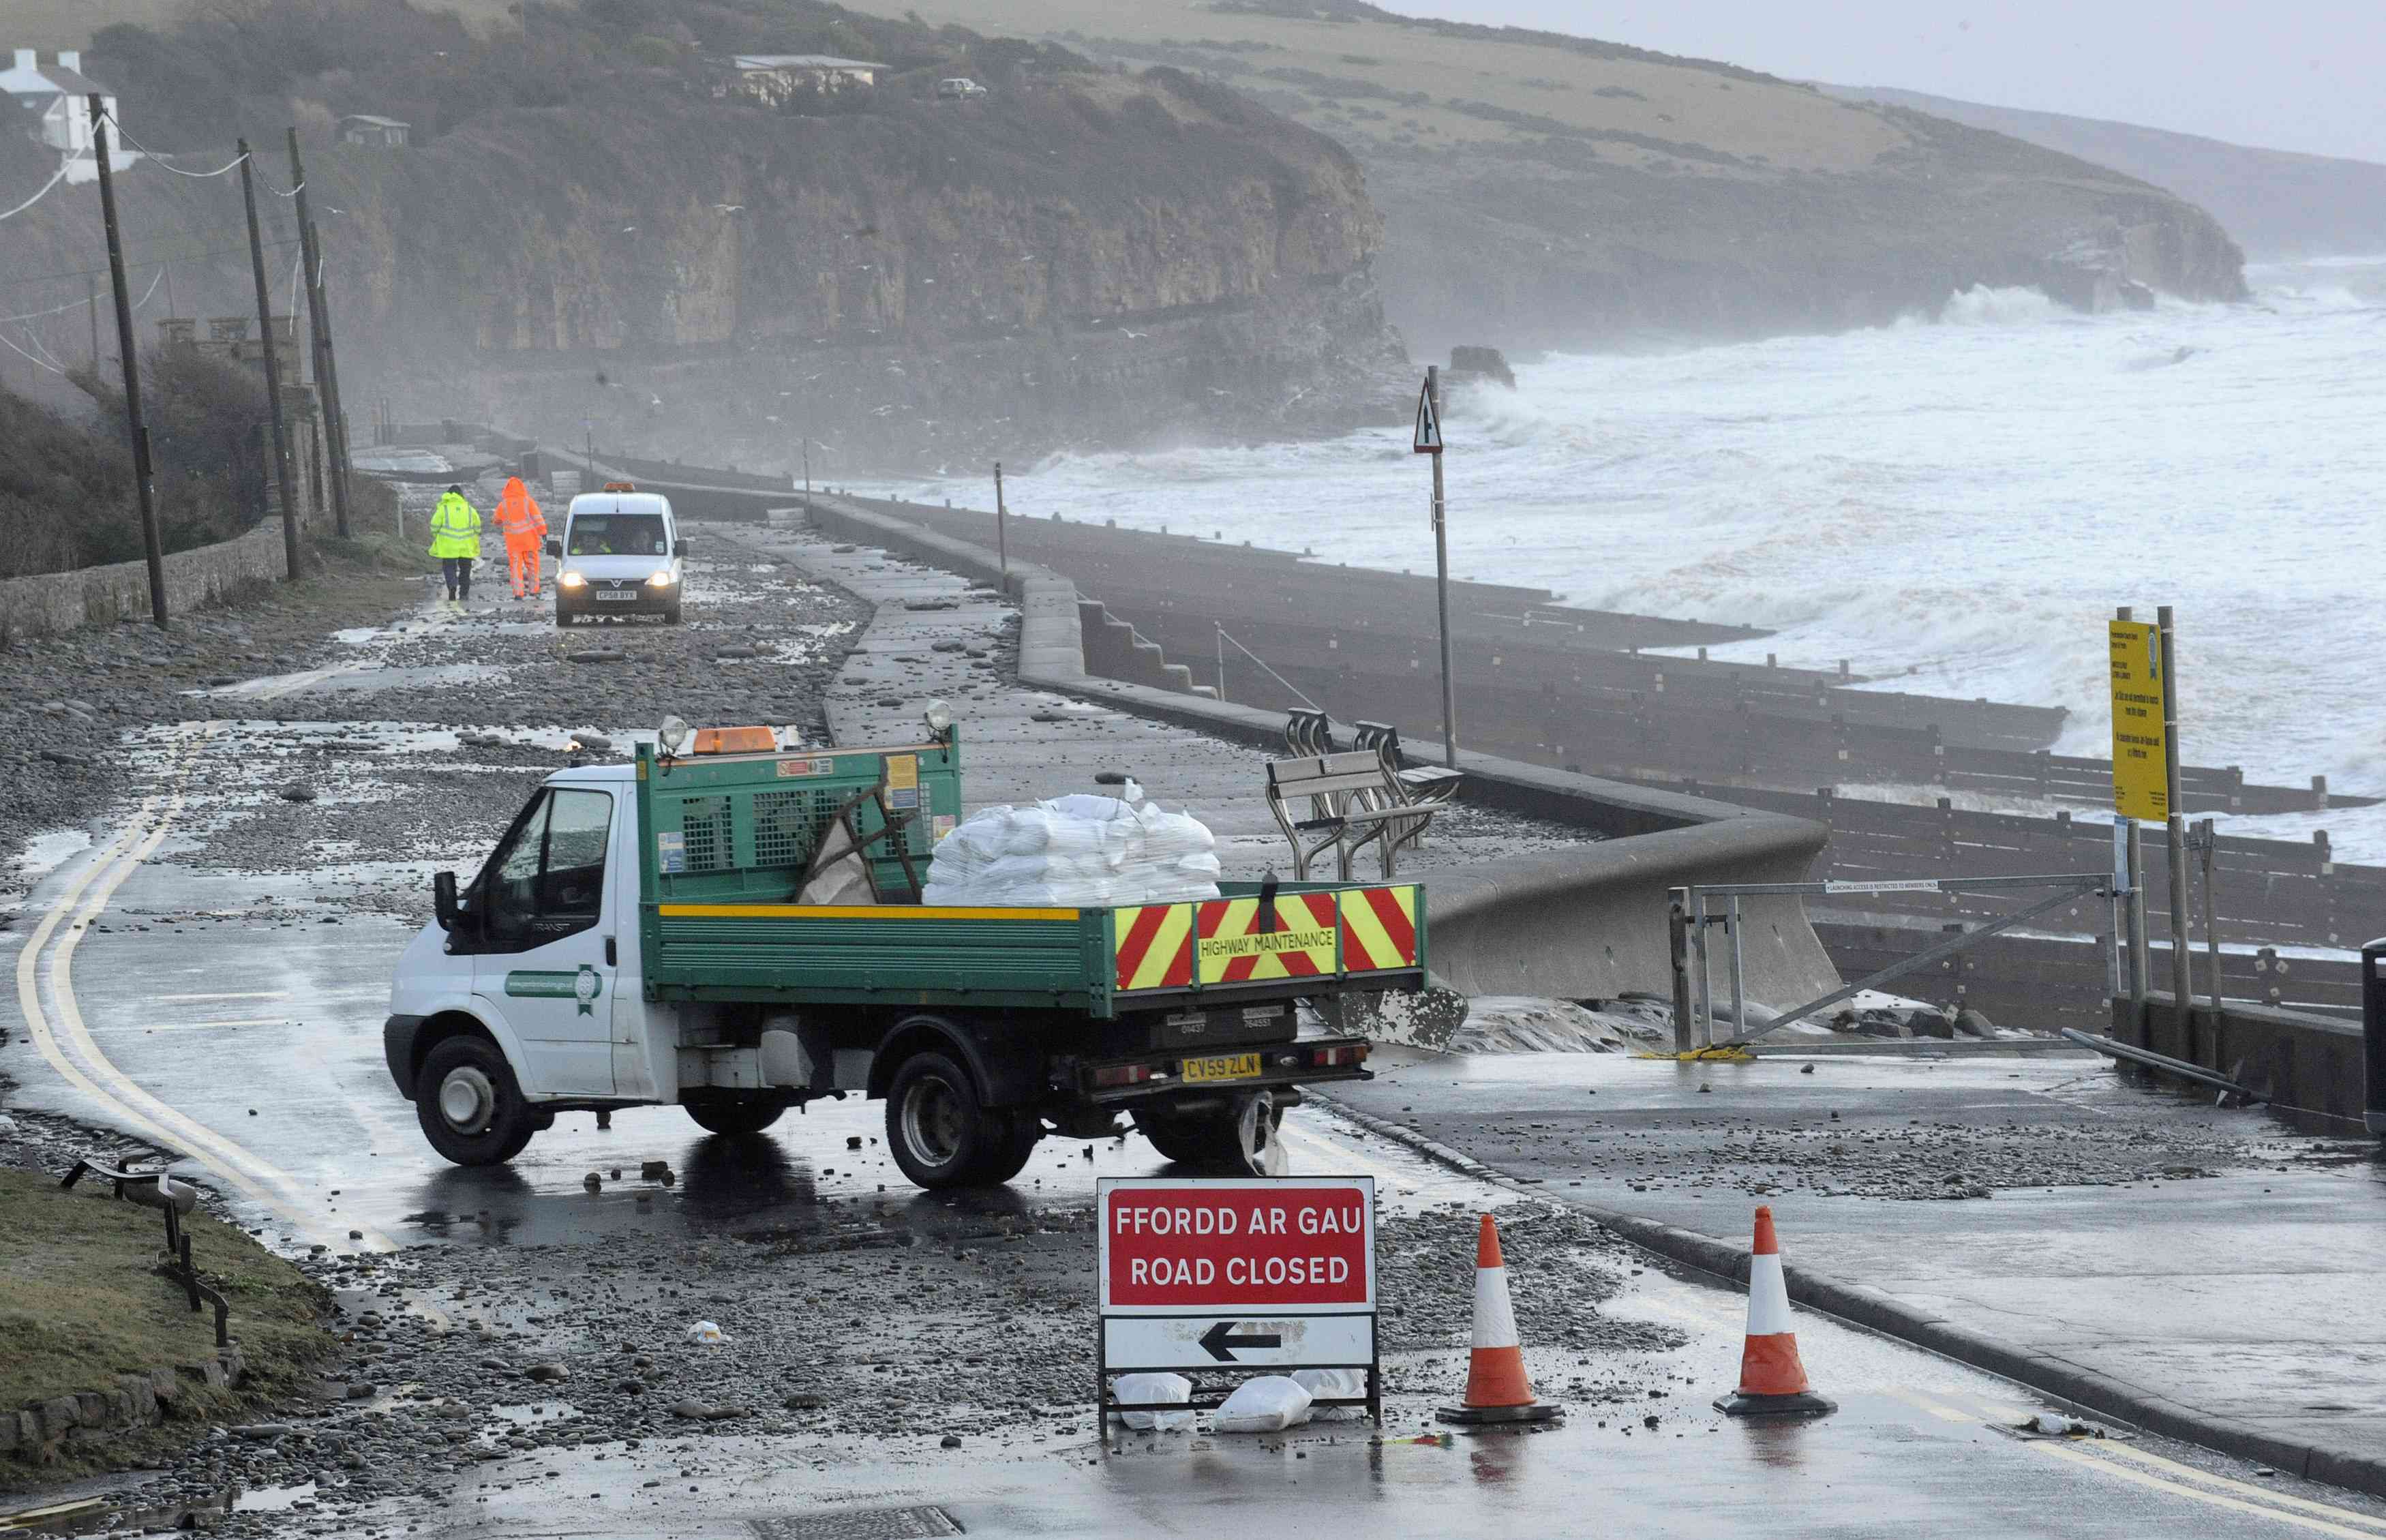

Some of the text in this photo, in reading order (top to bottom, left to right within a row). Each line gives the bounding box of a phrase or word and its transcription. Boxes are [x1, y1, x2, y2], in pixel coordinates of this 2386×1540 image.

[1200, 930, 1333, 956] HIGHWAY MAINTENANCE
[1188, 1055, 1256, 1078] CV59 ZLN
[1115, 1207, 1361, 1235] FFORDD AR GAU
[1131, 1256, 1348, 1286] ROAD CLOSED
